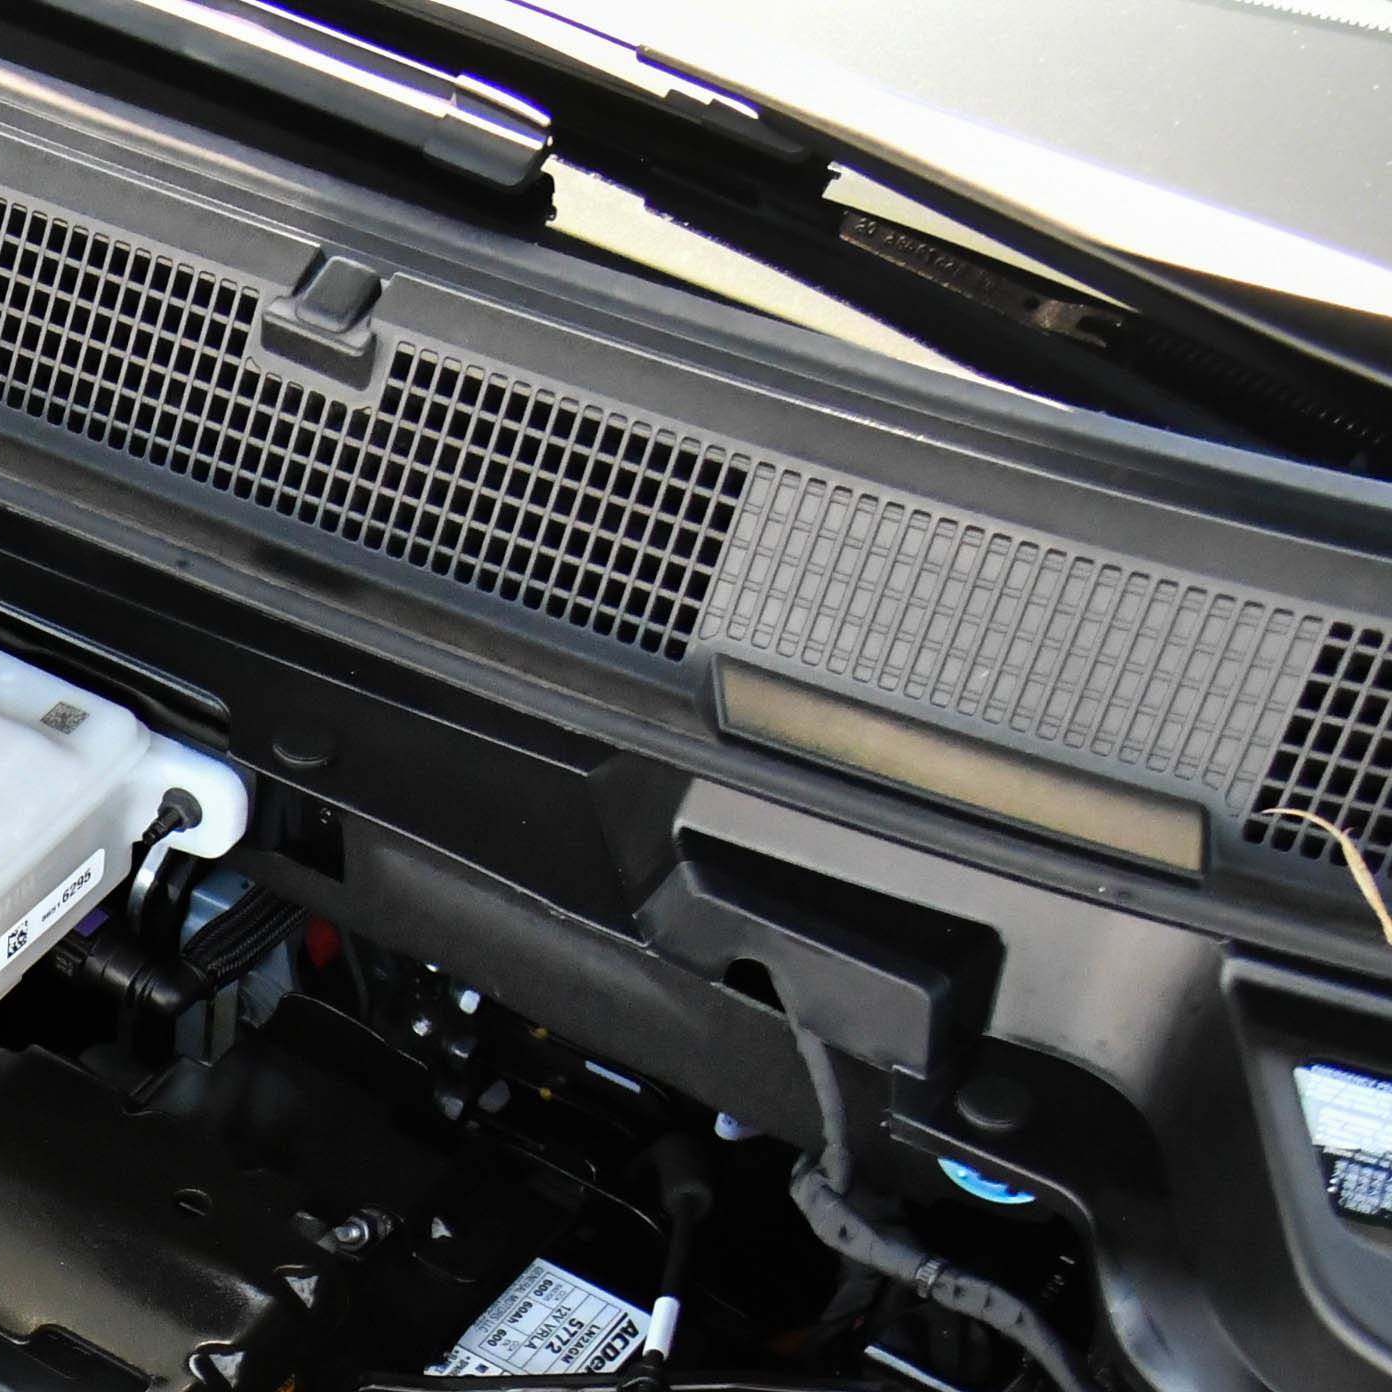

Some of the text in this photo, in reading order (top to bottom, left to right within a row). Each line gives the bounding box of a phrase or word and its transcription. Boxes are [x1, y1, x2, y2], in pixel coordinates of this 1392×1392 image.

[513, 1264, 544, 1296] GENERAL
[531, 1276, 553, 1298] 600
[487, 1292, 518, 1323] MOTORS
[505, 1298, 534, 1327] 60Ah
[549, 1303, 571, 1325] 12V
[478, 1318, 495, 1335] LLC
[485, 1327, 507, 1348] 600
[522, 1321, 555, 1351] VRLA
[544, 1316, 584, 1356] 5772
[560, 1322, 601, 1365] LN2AGM
